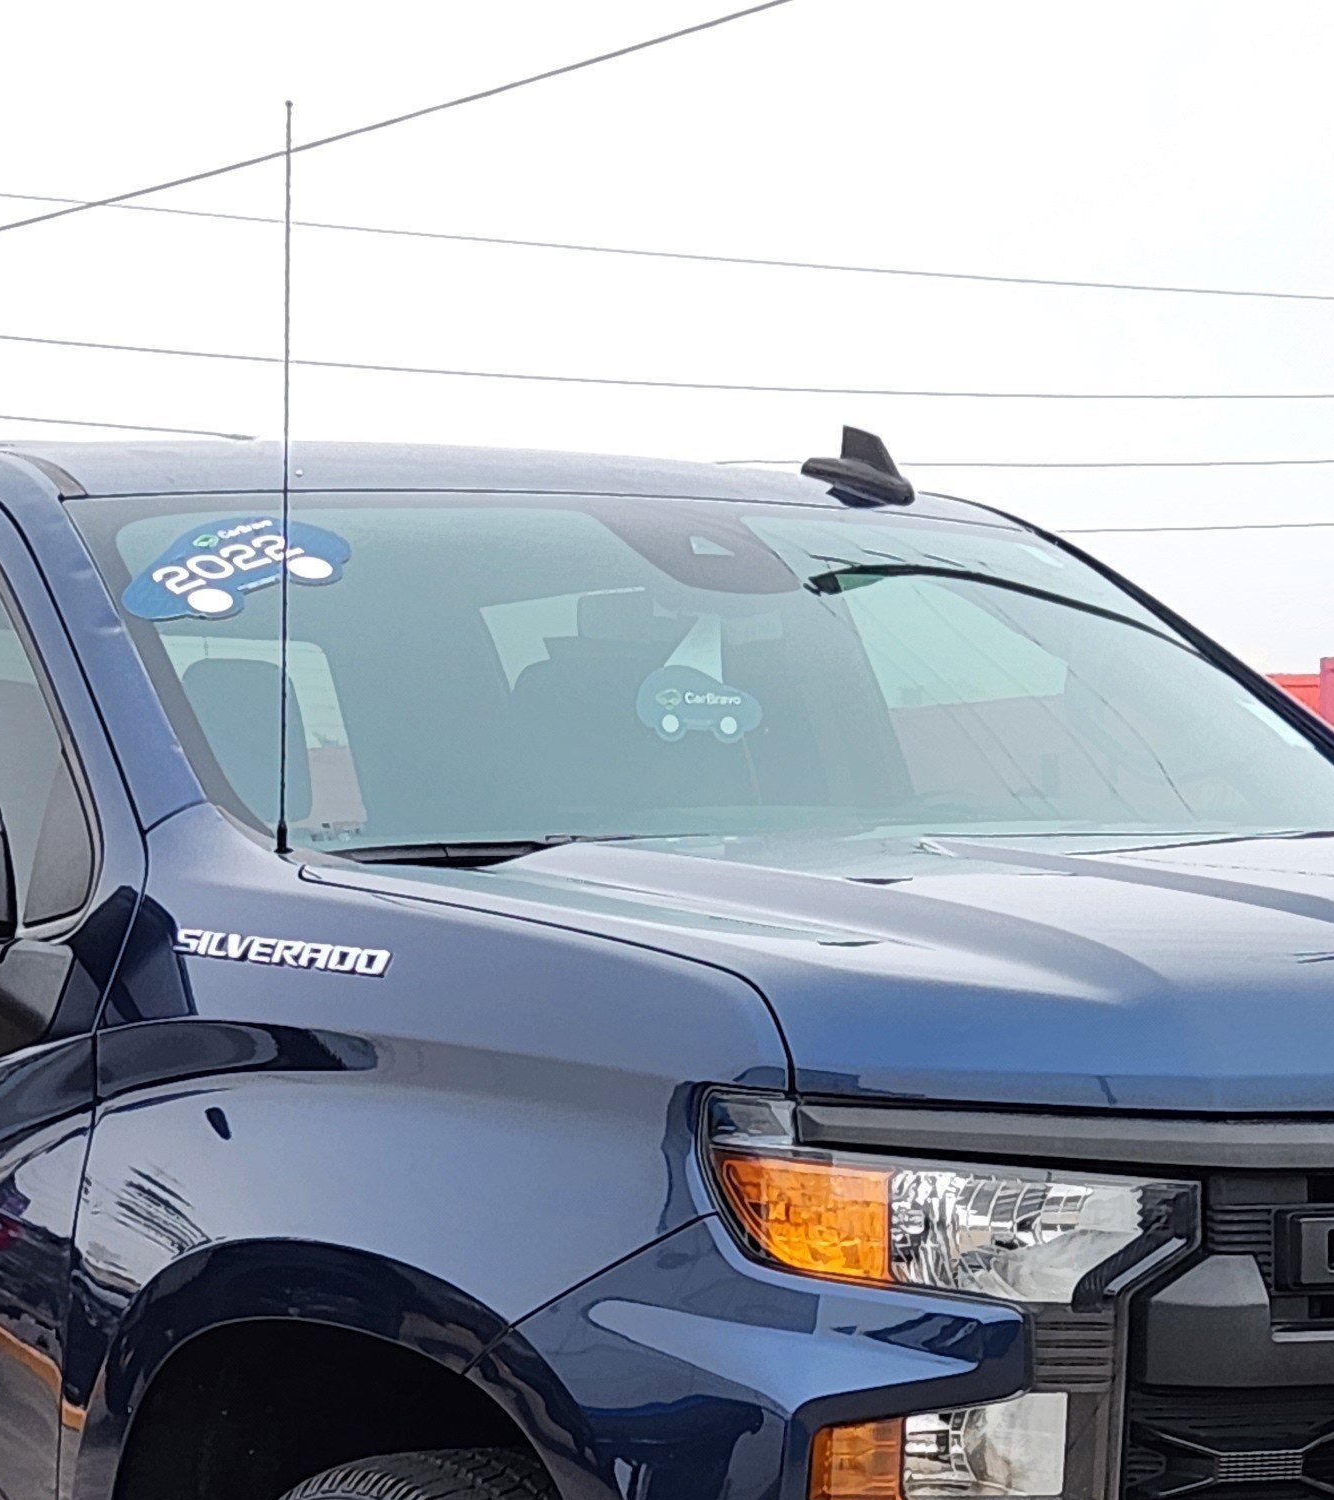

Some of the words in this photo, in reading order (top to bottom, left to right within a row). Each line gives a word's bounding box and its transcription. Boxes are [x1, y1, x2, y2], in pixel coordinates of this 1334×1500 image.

[152, 534, 305, 595] 2022
[684, 691, 742, 706] CarBravo
[172, 928, 392, 977] SILVERADO
